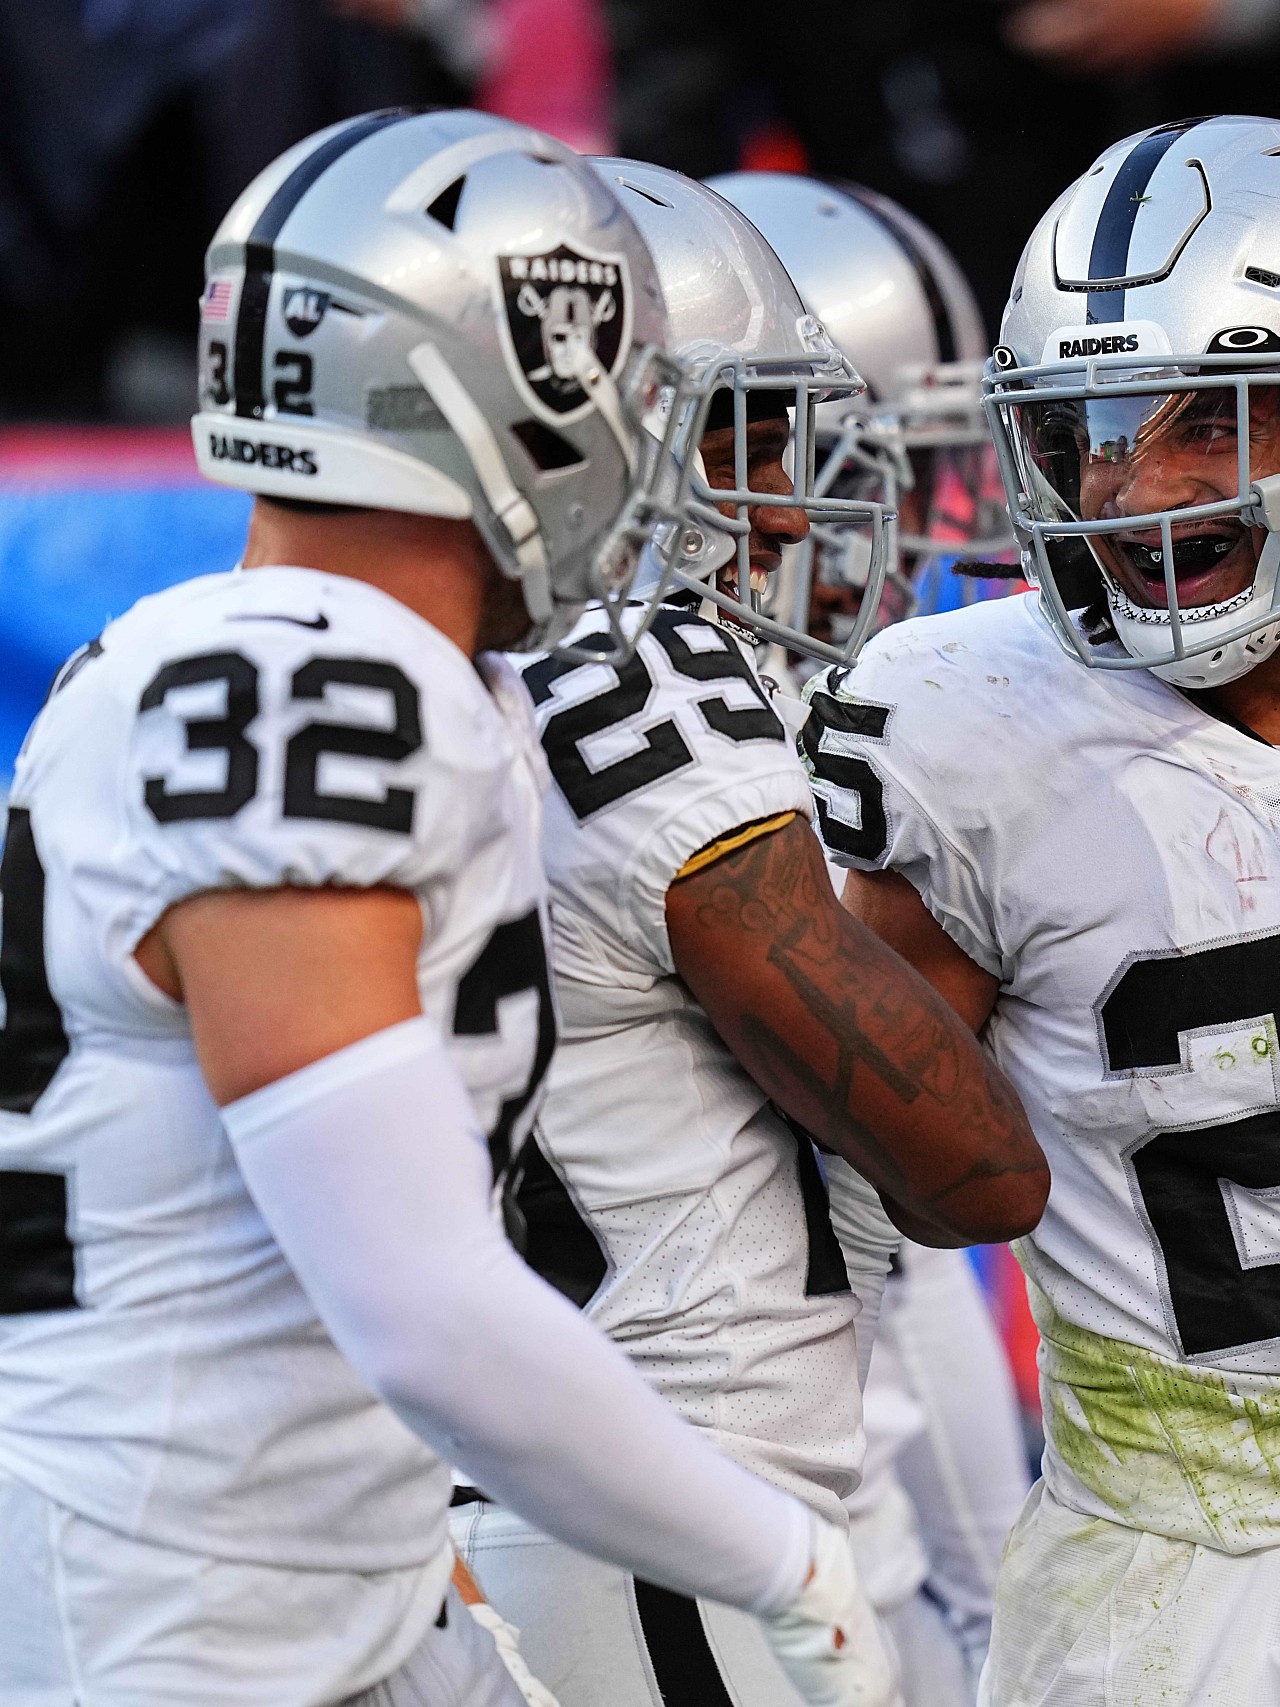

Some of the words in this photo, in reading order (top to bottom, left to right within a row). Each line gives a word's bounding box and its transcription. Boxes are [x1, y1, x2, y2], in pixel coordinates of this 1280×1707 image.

[509, 257, 618, 287] RAIDERS
[284, 291, 323, 321] AL
[1060, 334, 1139, 358] RAIDERS
[210, 434, 319, 476] RAIDERS
[520, 606, 788, 822] 29
[139, 649, 424, 834] 32
